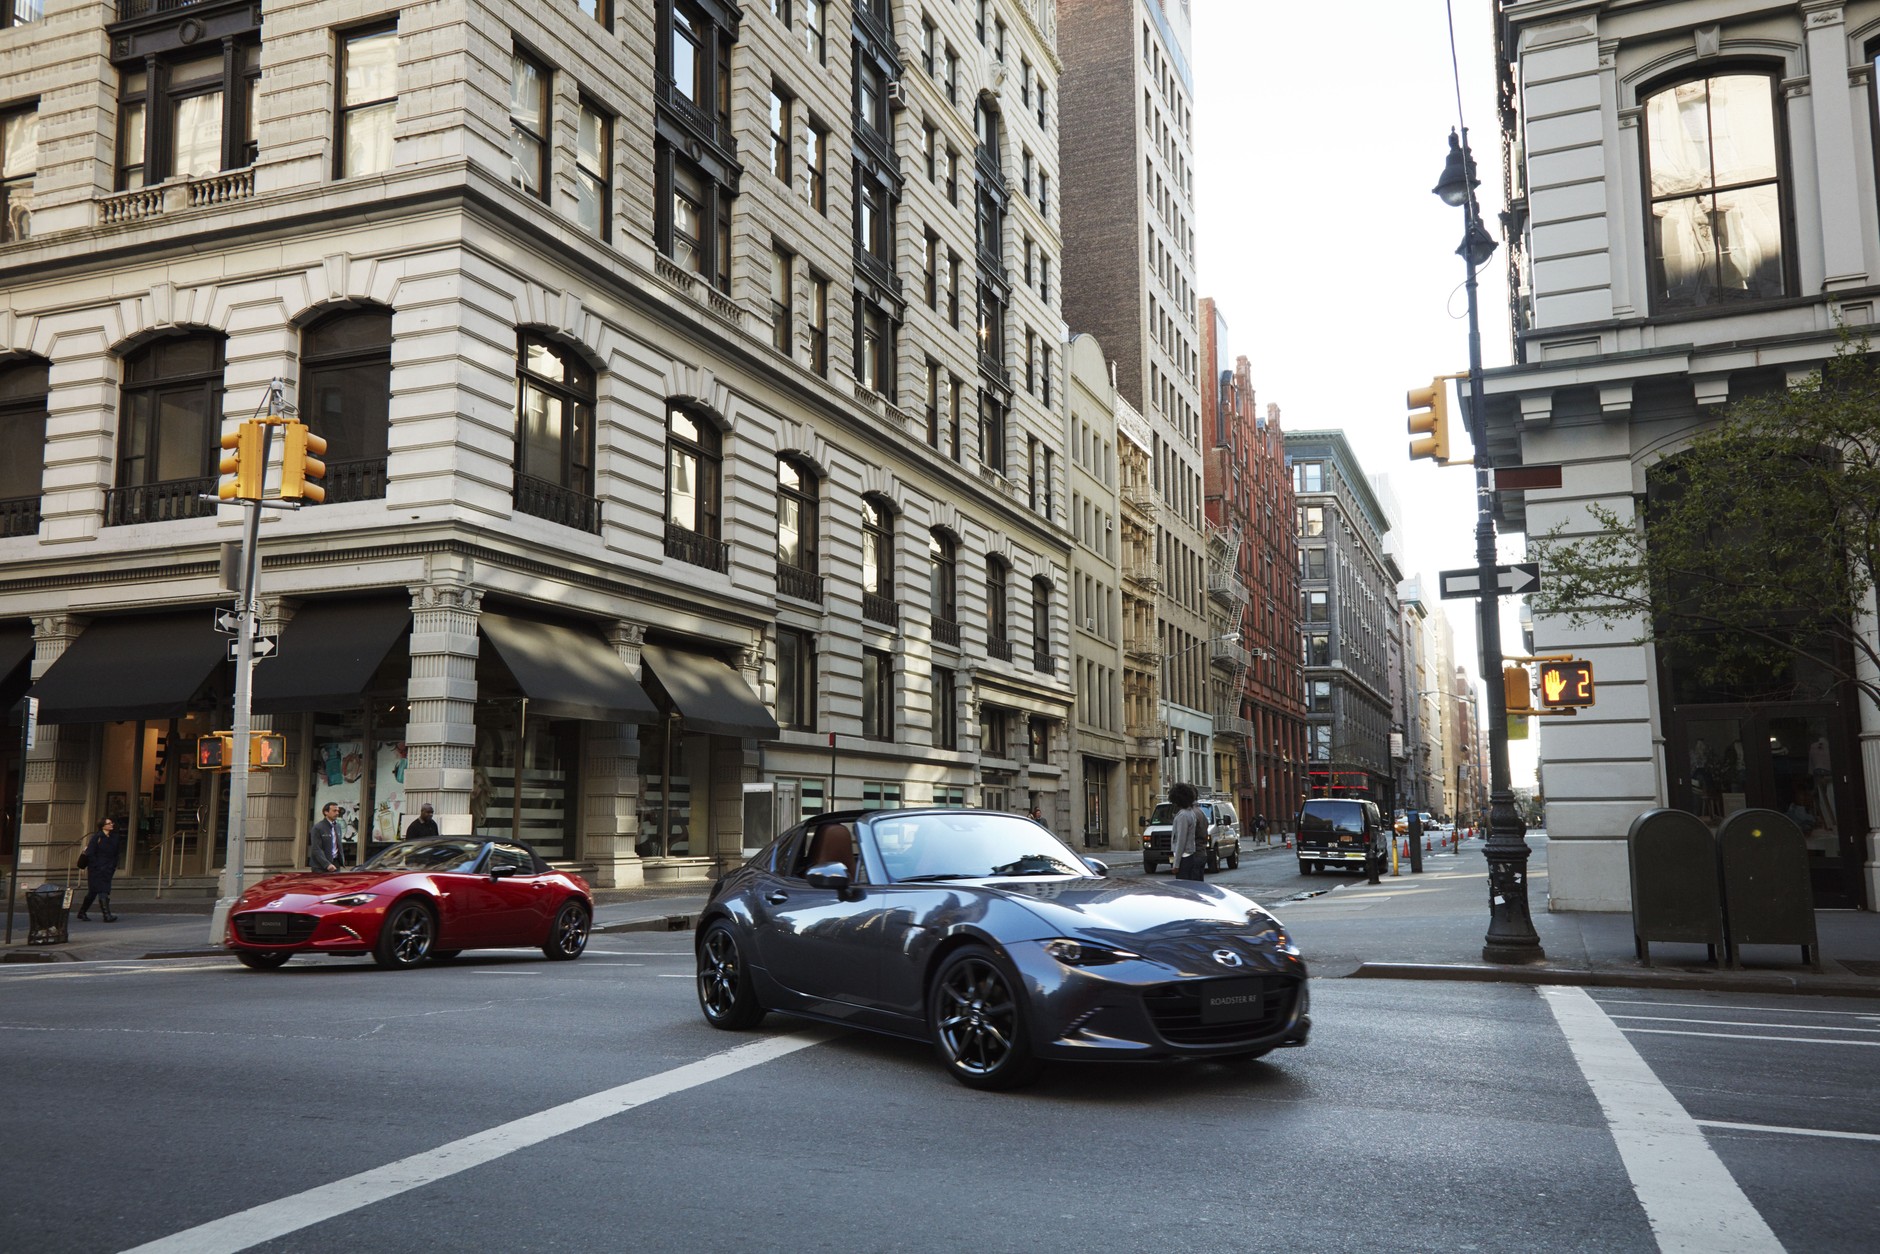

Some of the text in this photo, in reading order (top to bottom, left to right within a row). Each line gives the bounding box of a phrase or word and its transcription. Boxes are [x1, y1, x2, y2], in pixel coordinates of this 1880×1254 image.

[1577, 669, 1590, 697] 2
[1210, 994, 1257, 1006] ROADSTER RF
